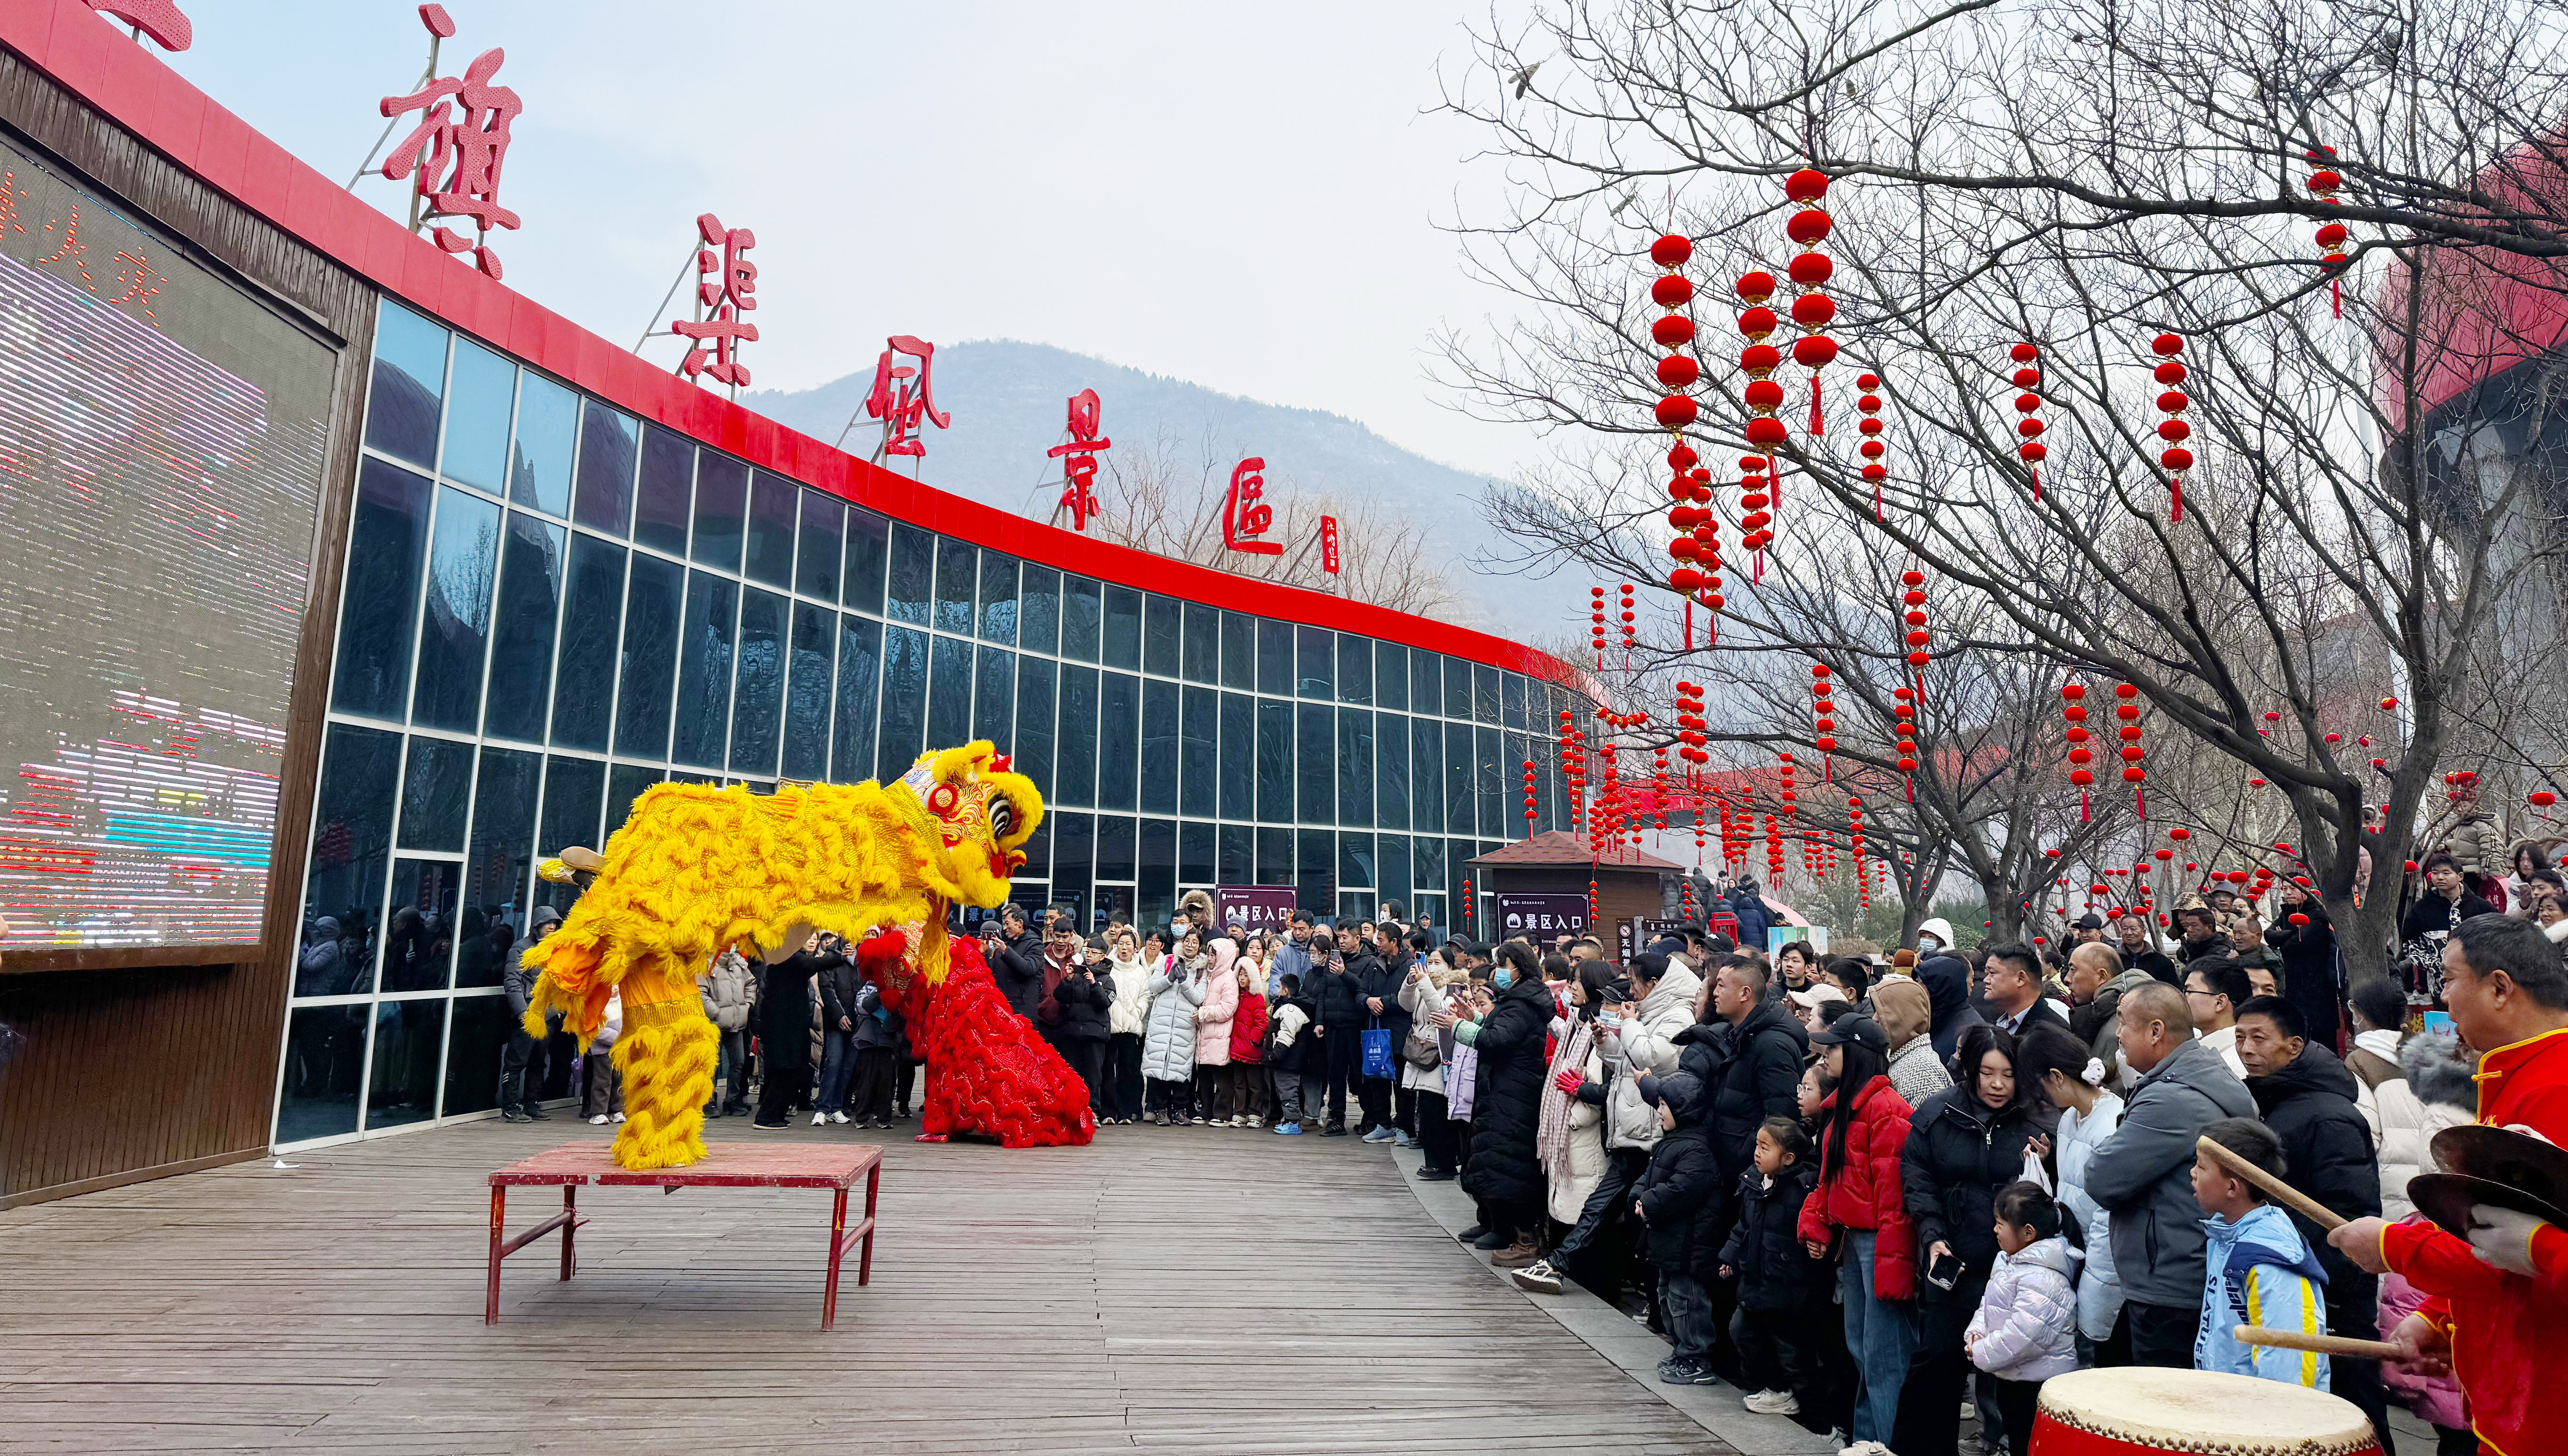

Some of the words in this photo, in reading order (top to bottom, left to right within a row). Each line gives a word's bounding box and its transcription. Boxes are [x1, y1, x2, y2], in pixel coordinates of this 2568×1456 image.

[1239, 905, 1287, 921] 景区入口
[1525, 913, 1582, 930] 景区入口
